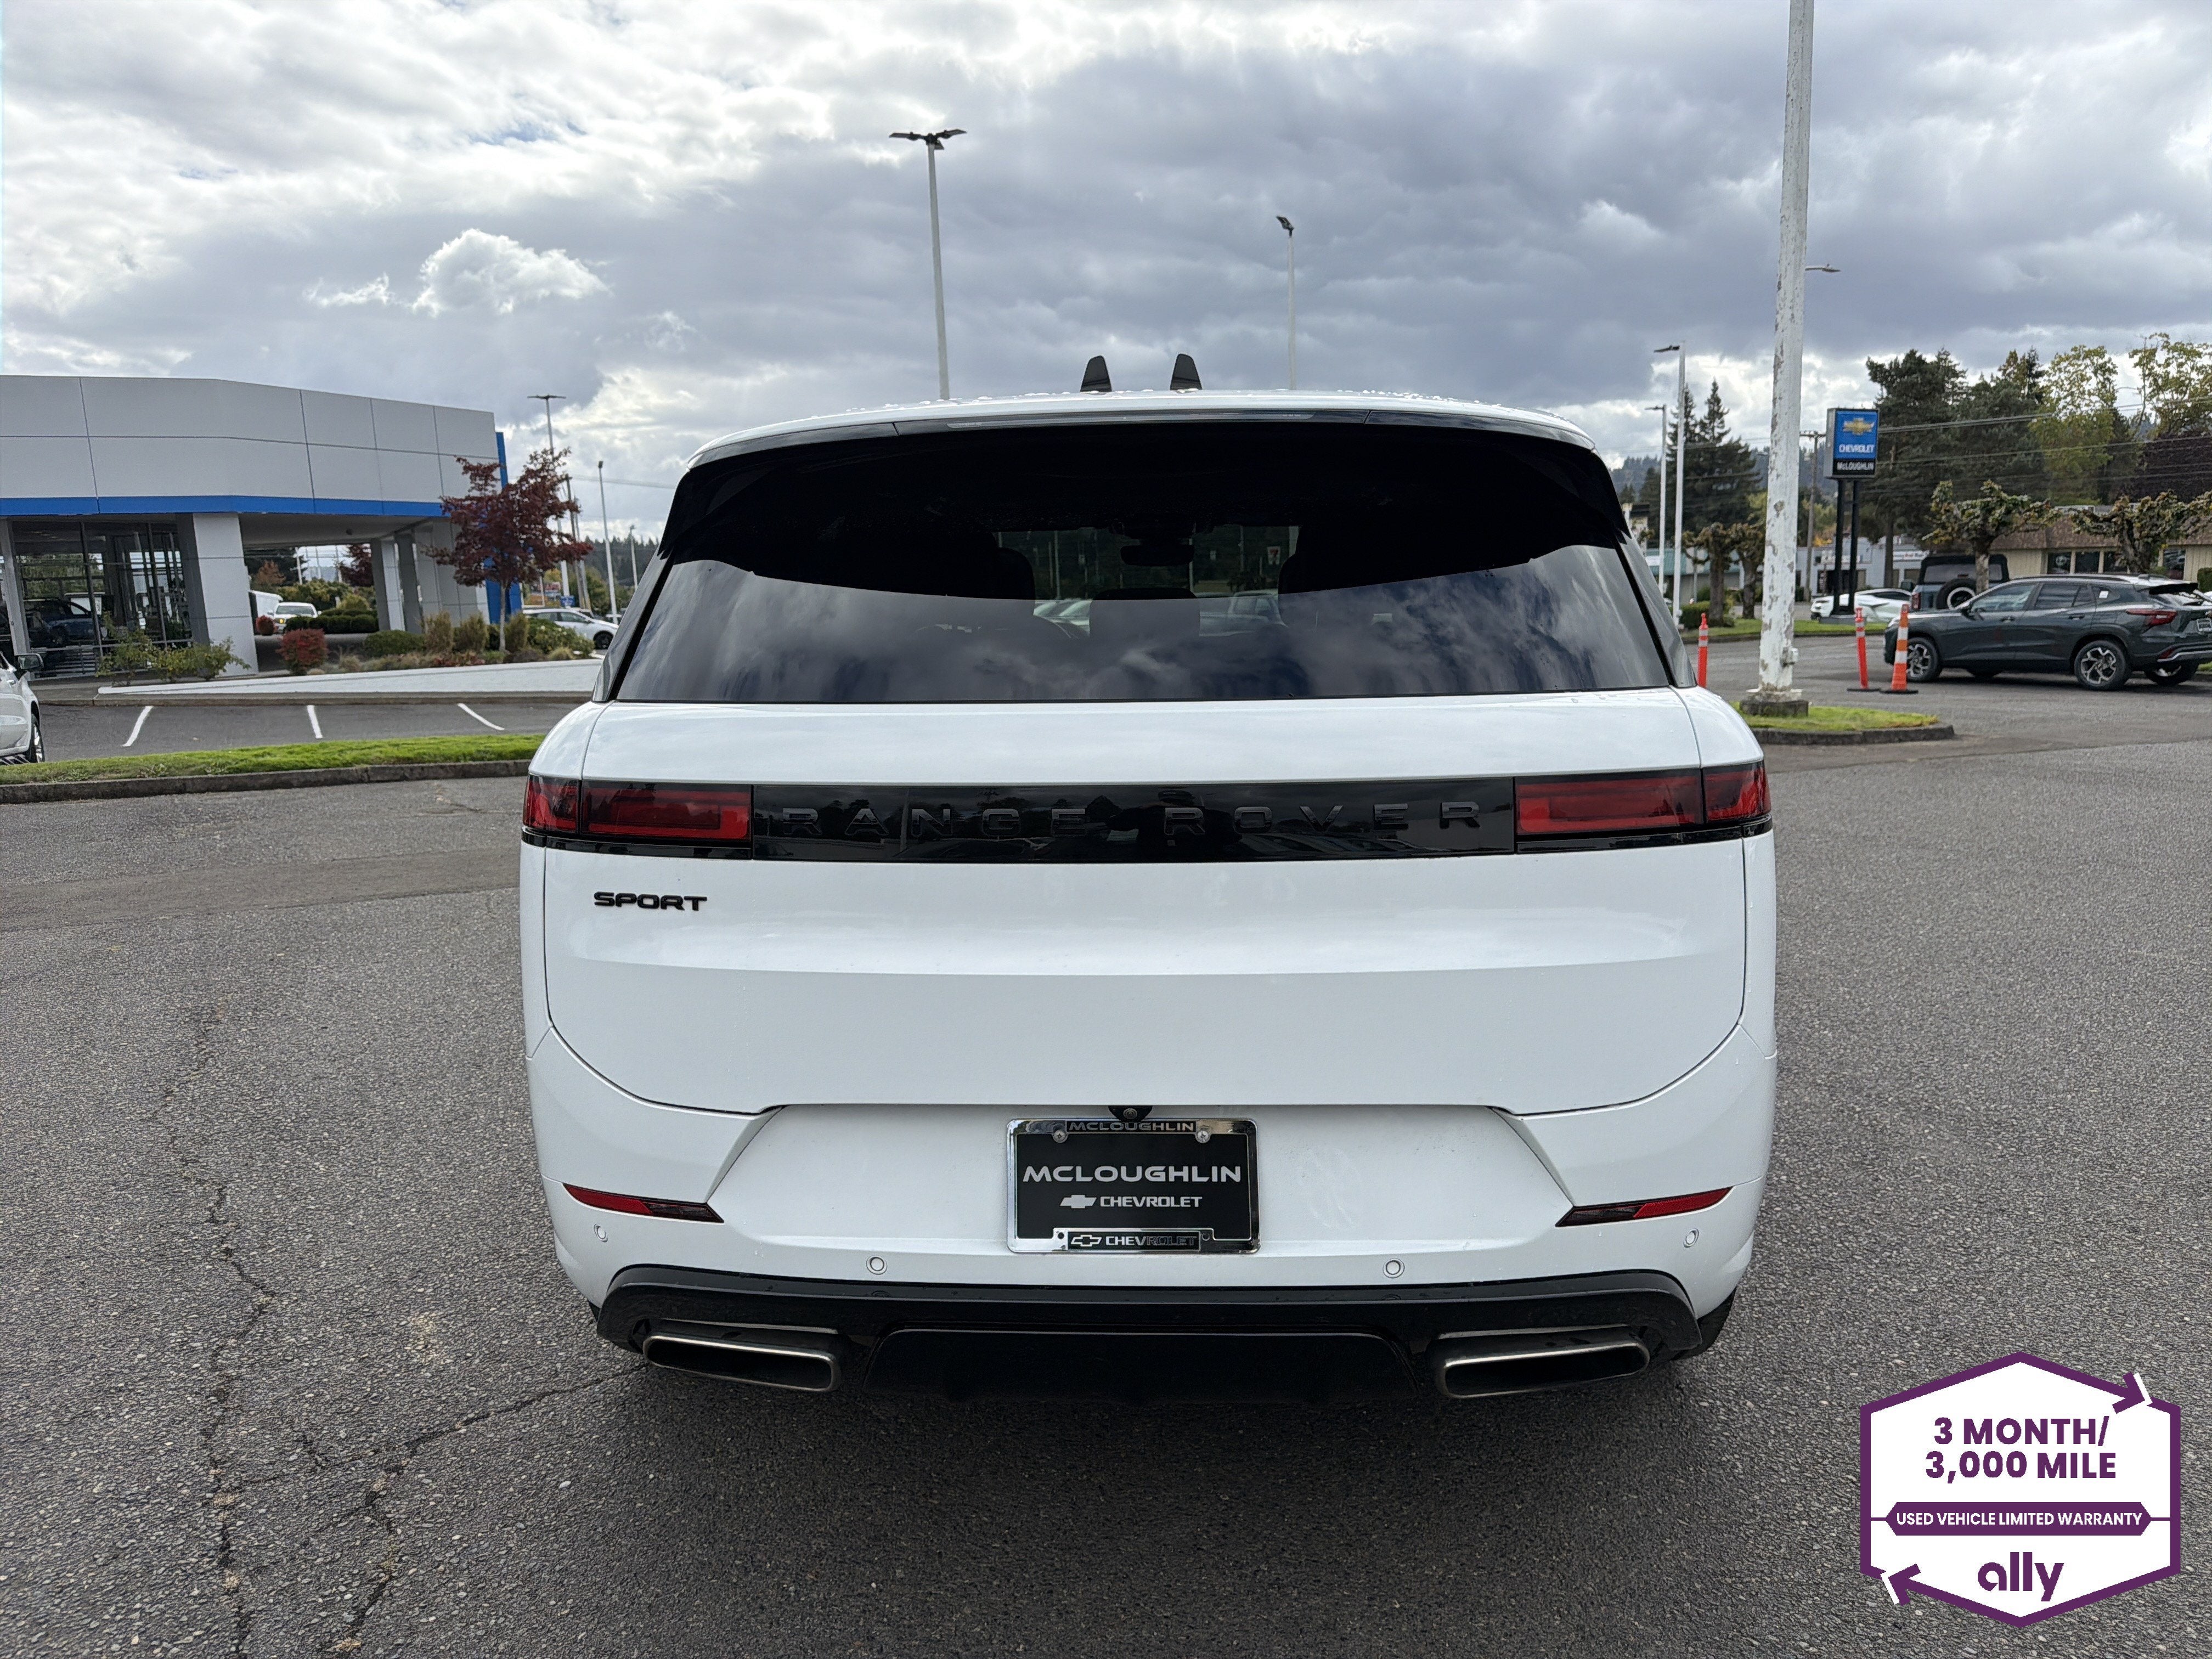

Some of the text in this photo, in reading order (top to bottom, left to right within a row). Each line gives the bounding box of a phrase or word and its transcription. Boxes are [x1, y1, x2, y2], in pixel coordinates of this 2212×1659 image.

[1839, 444, 1875, 453] CHEVROLET
[783, 802, 1480, 836] RANGE ROVER
[594, 891, 707, 911] SPORT
[1069, 1122, 1194, 1131] MCLOUGHLIN
[1023, 1166, 1241, 1182] MCLOUGHLIN
[1100, 1196, 1203, 1207] CHEVROLET
[1105, 1236, 1197, 1246] CHEVROLET
